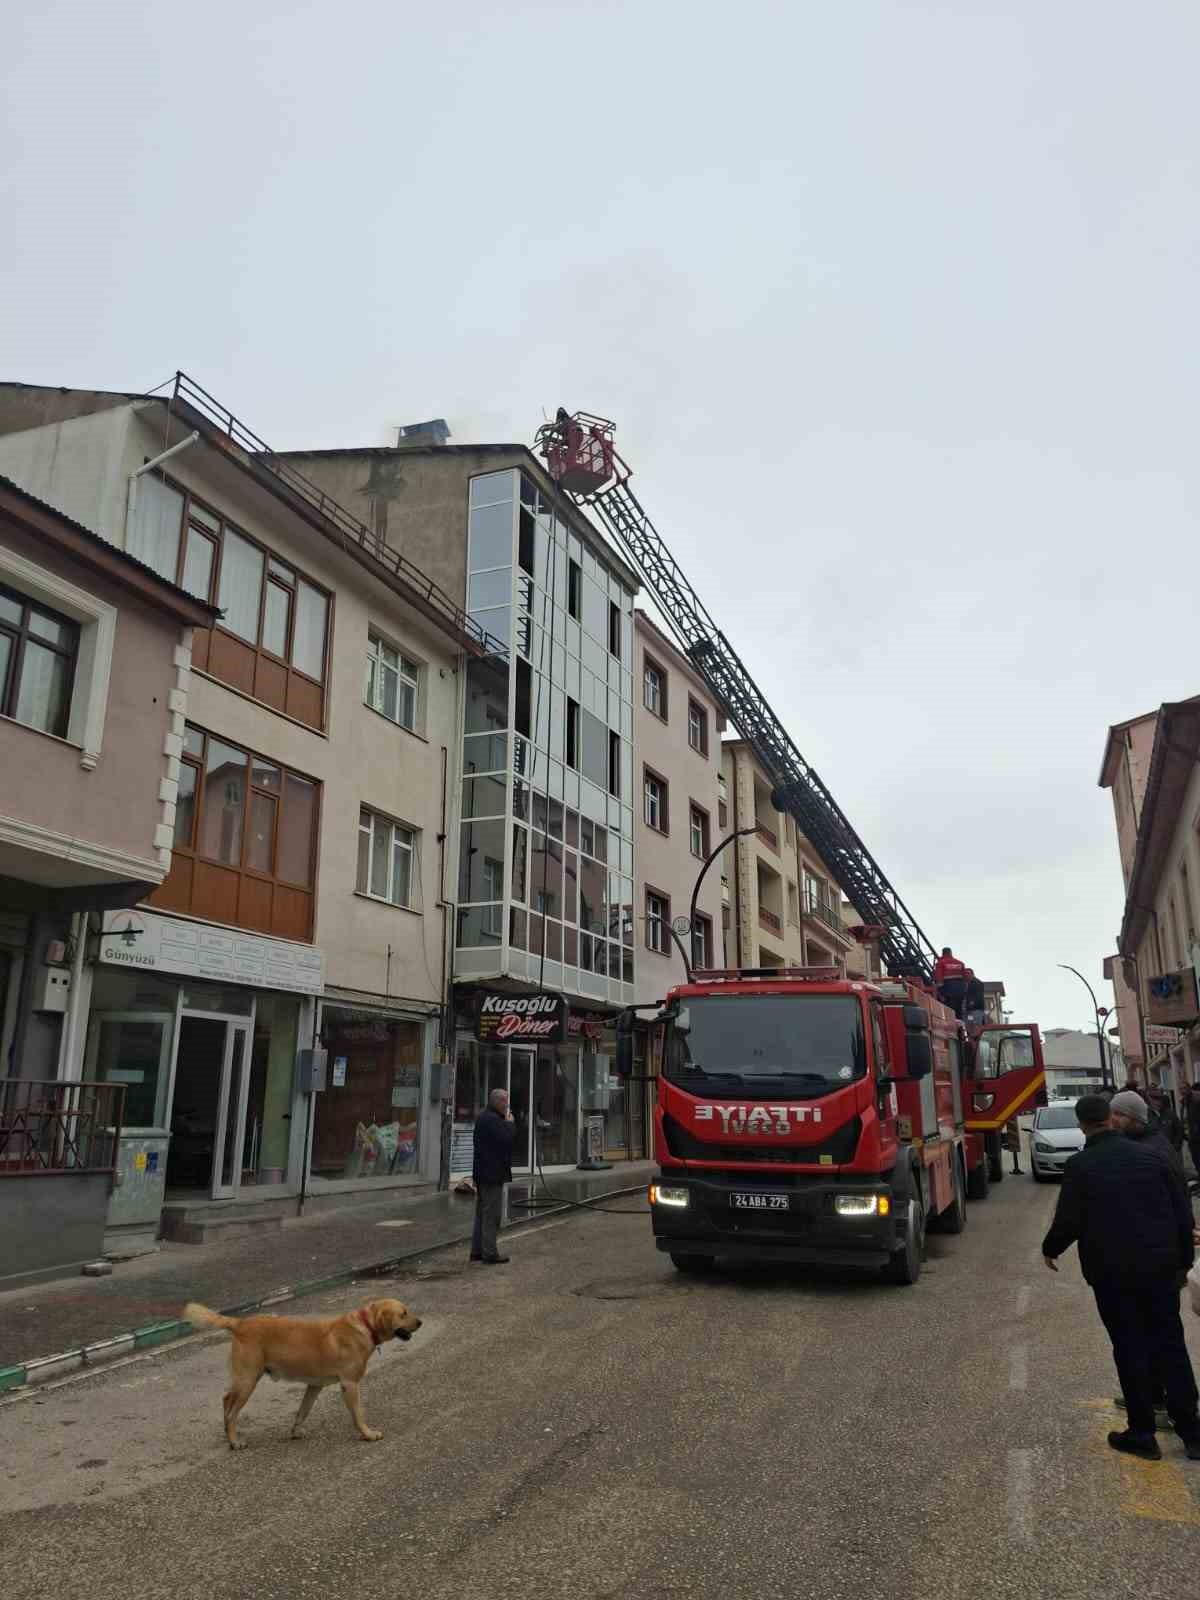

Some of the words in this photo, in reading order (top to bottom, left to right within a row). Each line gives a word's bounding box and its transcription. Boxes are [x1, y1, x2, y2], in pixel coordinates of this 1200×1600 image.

[105, 948, 155, 966] Günyüzü
[496, 1013, 560, 1039] Döner
[722, 1119, 792, 1136] IVECO
[735, 1195, 748, 1207] 24
[748, 1195, 767, 1207] ABA
[768, 1197, 788, 1208] 275
